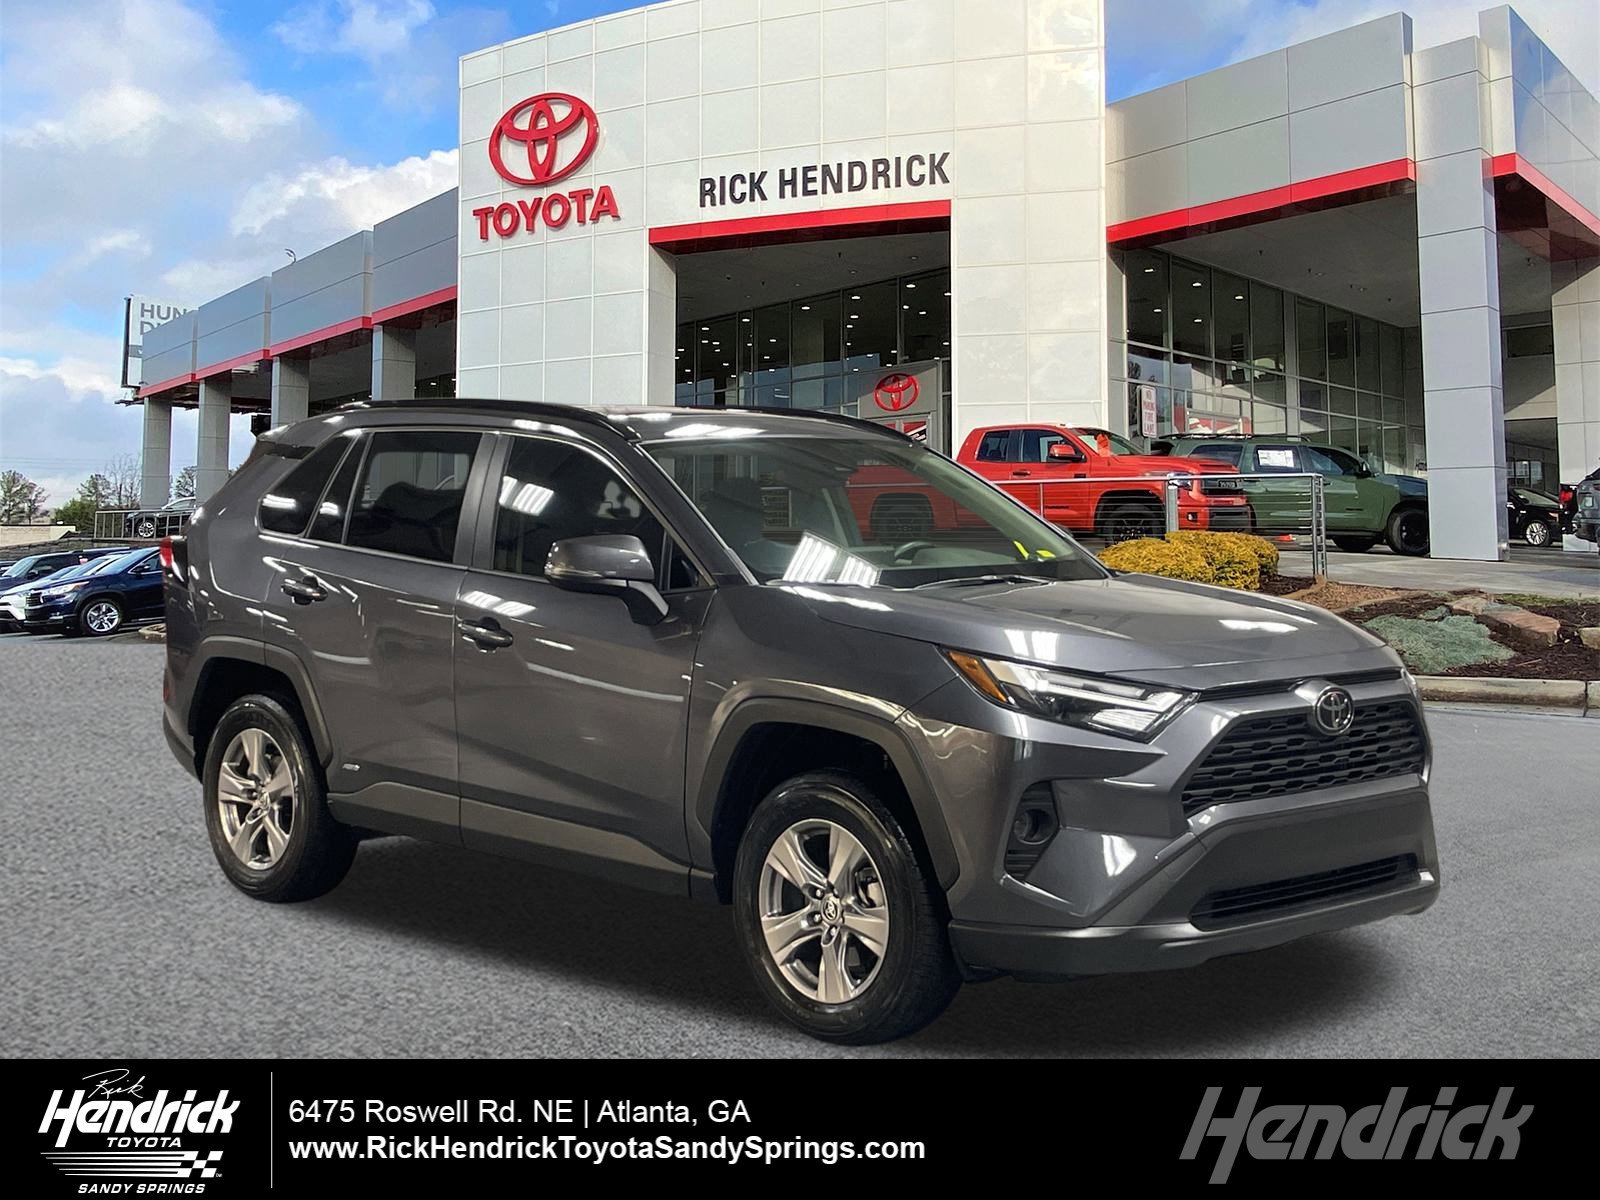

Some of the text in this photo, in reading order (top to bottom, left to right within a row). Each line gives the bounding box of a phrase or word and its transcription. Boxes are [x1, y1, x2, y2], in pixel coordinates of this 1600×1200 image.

[700, 153, 949, 207] RICK HENDRICK
[473, 185, 620, 240] TOYOTA
